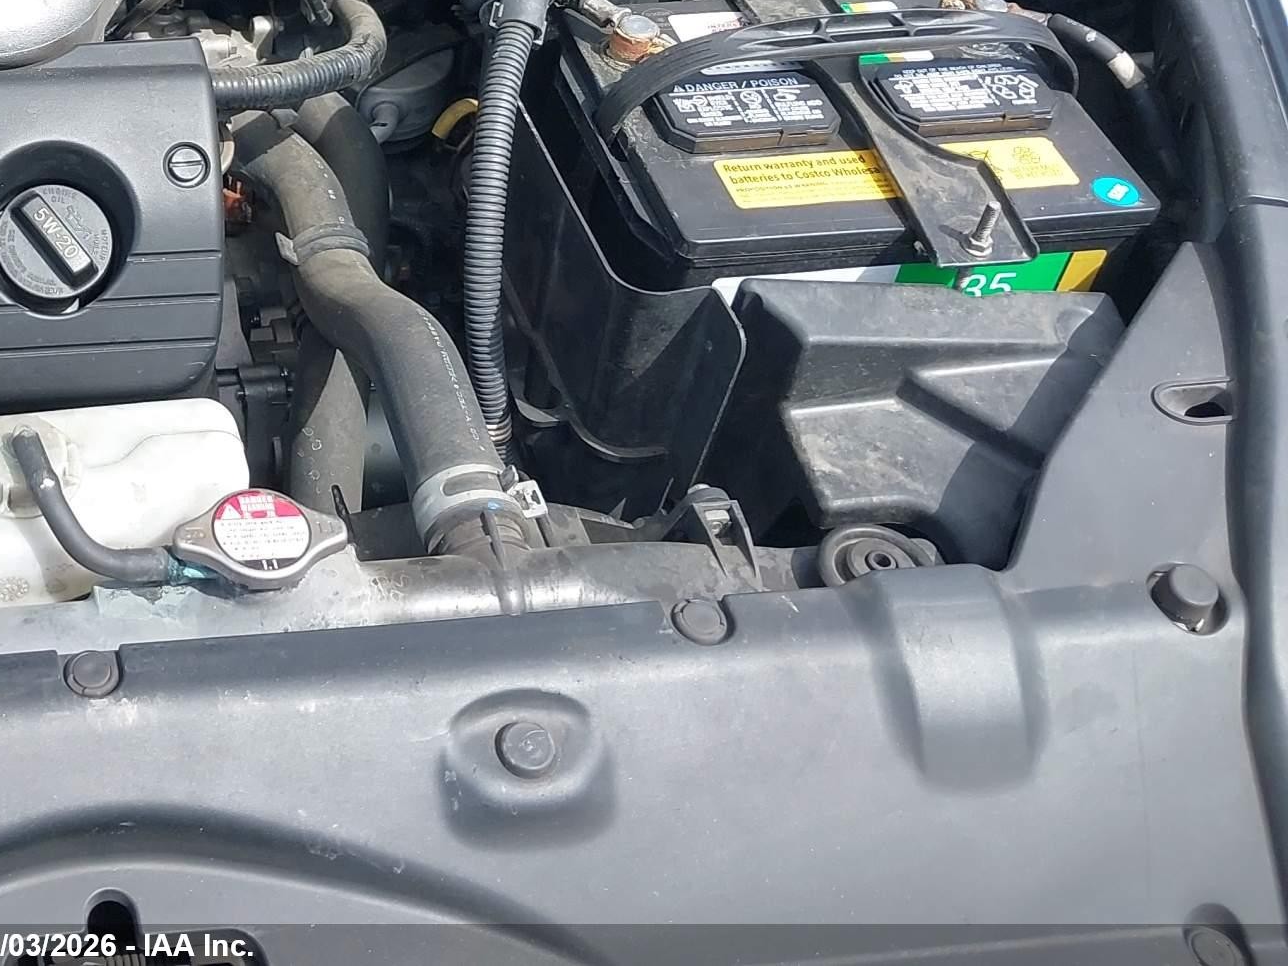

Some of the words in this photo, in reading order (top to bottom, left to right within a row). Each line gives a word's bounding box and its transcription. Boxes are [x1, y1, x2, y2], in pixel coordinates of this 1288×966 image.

[685, 81, 738, 93] DANGER
[750, 78, 799, 88] POISON
[723, 163, 762, 173] Return
[763, 159, 814, 170] warranty
[816, 155, 837, 166] and
[839, 154, 866, 165] used
[729, 172, 780, 185] batteries
[781, 171, 791, 180] to
[795, 168, 831, 180] Costco
[833, 165, 881, 178] Wholesa
[33, 207, 79, 258] 5W-20
